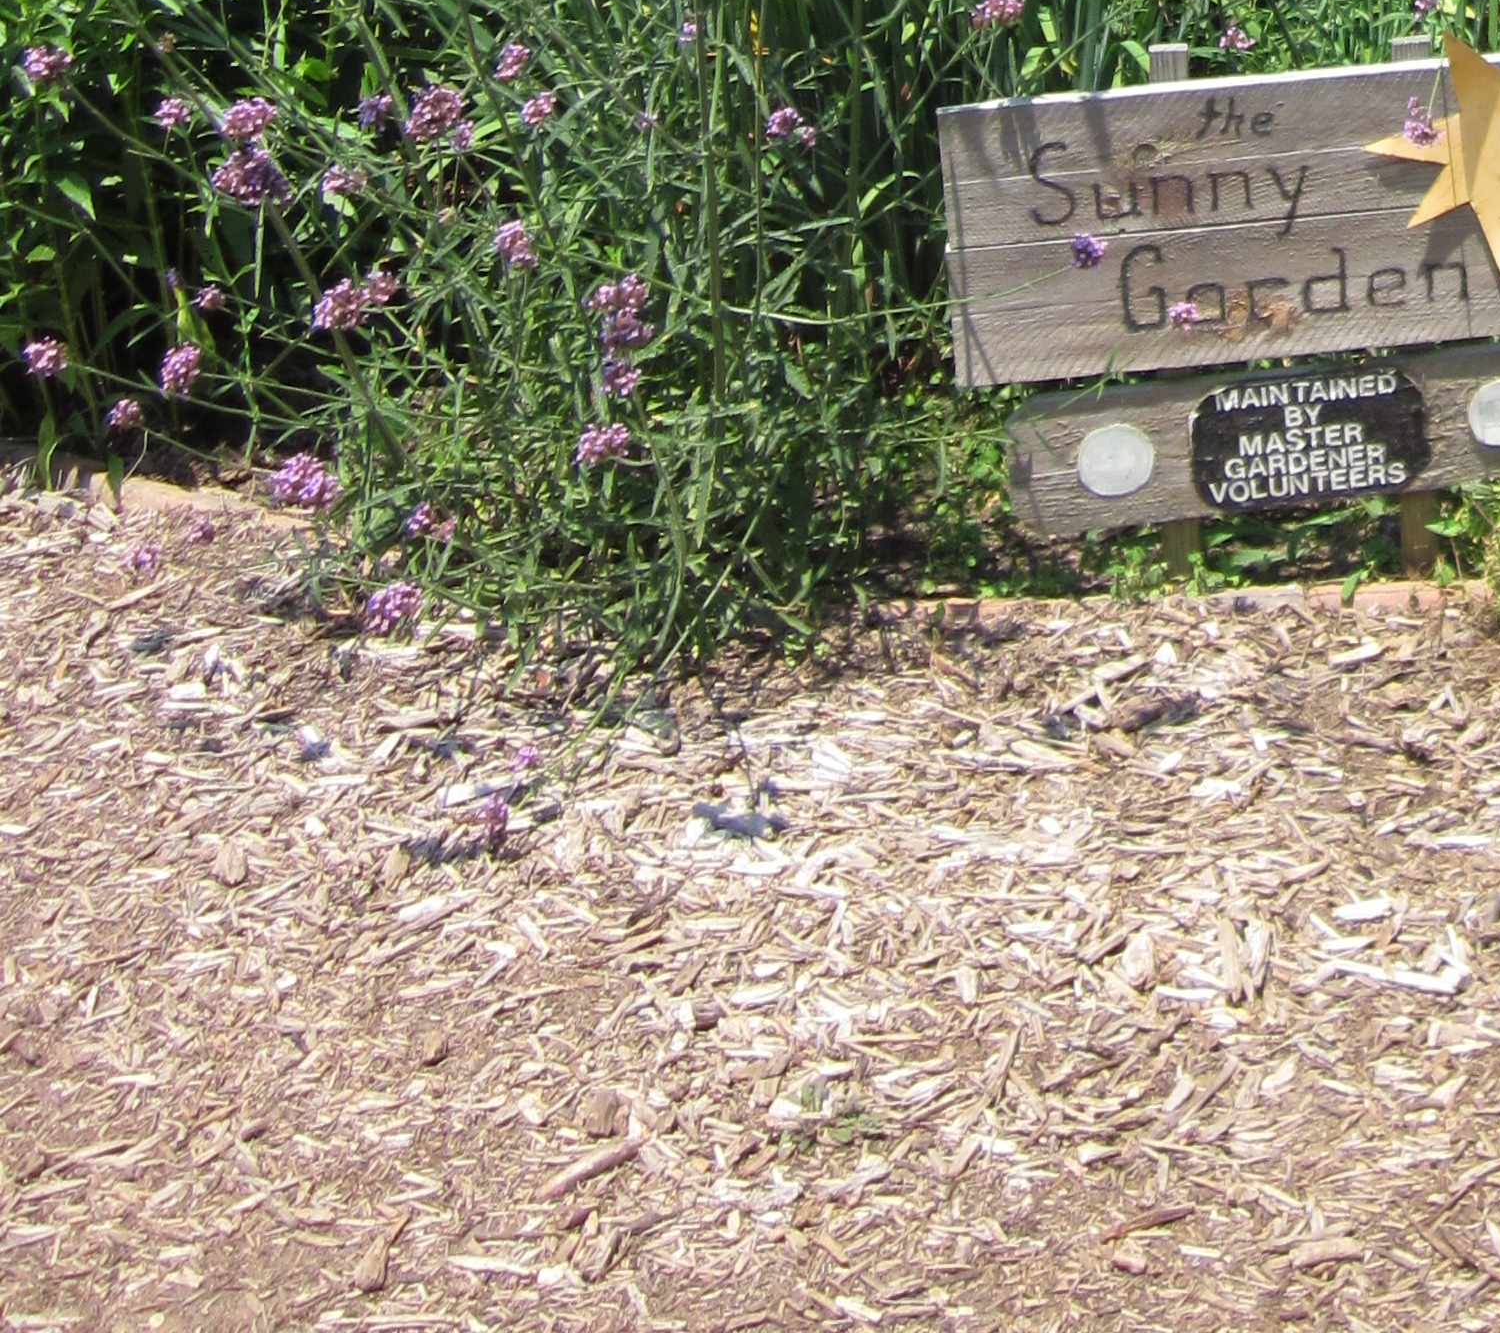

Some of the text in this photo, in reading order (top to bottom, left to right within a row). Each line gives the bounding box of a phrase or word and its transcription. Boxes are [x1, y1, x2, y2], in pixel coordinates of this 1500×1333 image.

[1197, 96, 1275, 138] the
[1029, 140, 1311, 240] Sunny
[1119, 243, 1469, 334] Garden
[1214, 373, 1397, 412] MAINTAINED
[1283, 403, 1323, 428] BY
[1238, 422, 1364, 458] MASTER
[1224, 443, 1388, 480] GARDENER
[1208, 462, 1407, 505] VOLUNTEERS
